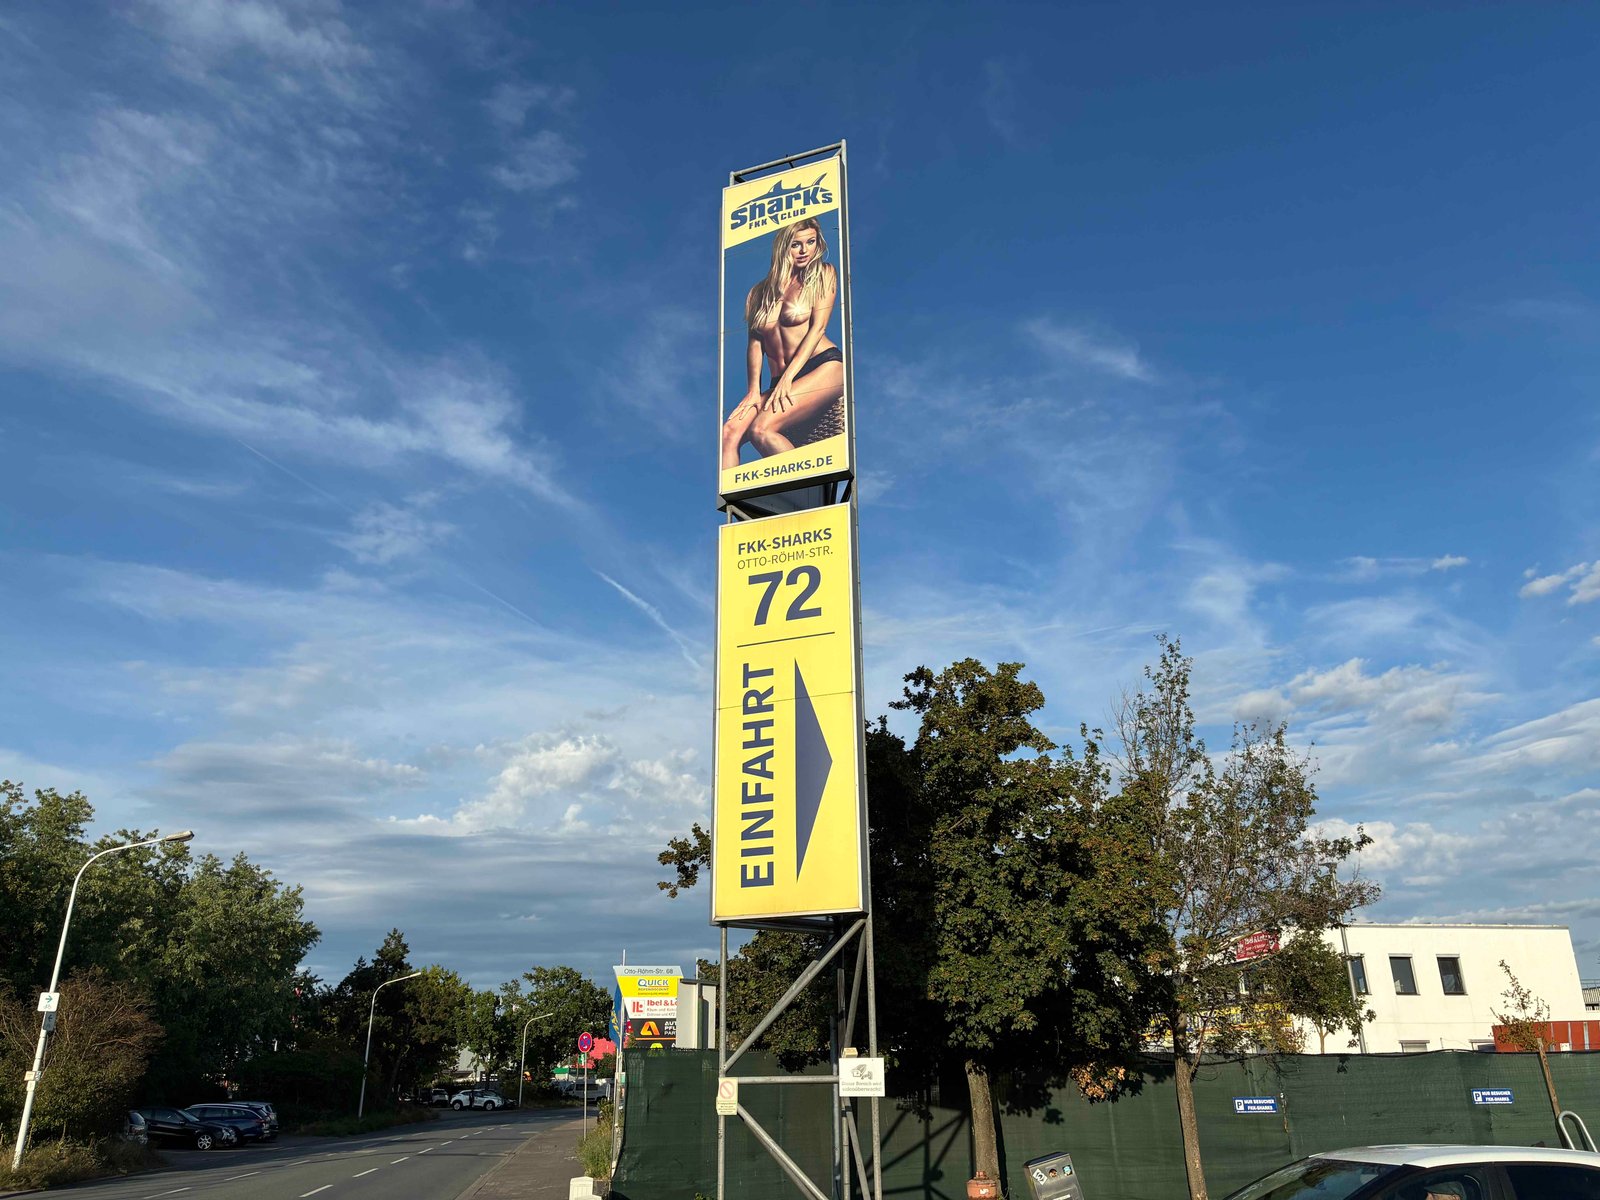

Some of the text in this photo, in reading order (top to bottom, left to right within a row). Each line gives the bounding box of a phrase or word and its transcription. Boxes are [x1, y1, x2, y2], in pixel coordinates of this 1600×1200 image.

[749, 208, 806, 229] FKK CLUB
[735, 455, 833, 483] FKK-SHARKS.DE
[738, 528, 832, 555] FKK-SHARKS
[737, 545, 833, 570] OTTO-RÖHM-STR.
[748, 565, 822, 626] 72
[741, 663, 774, 888] EINFAHRT
[638, 979, 668, 987] QUICK
